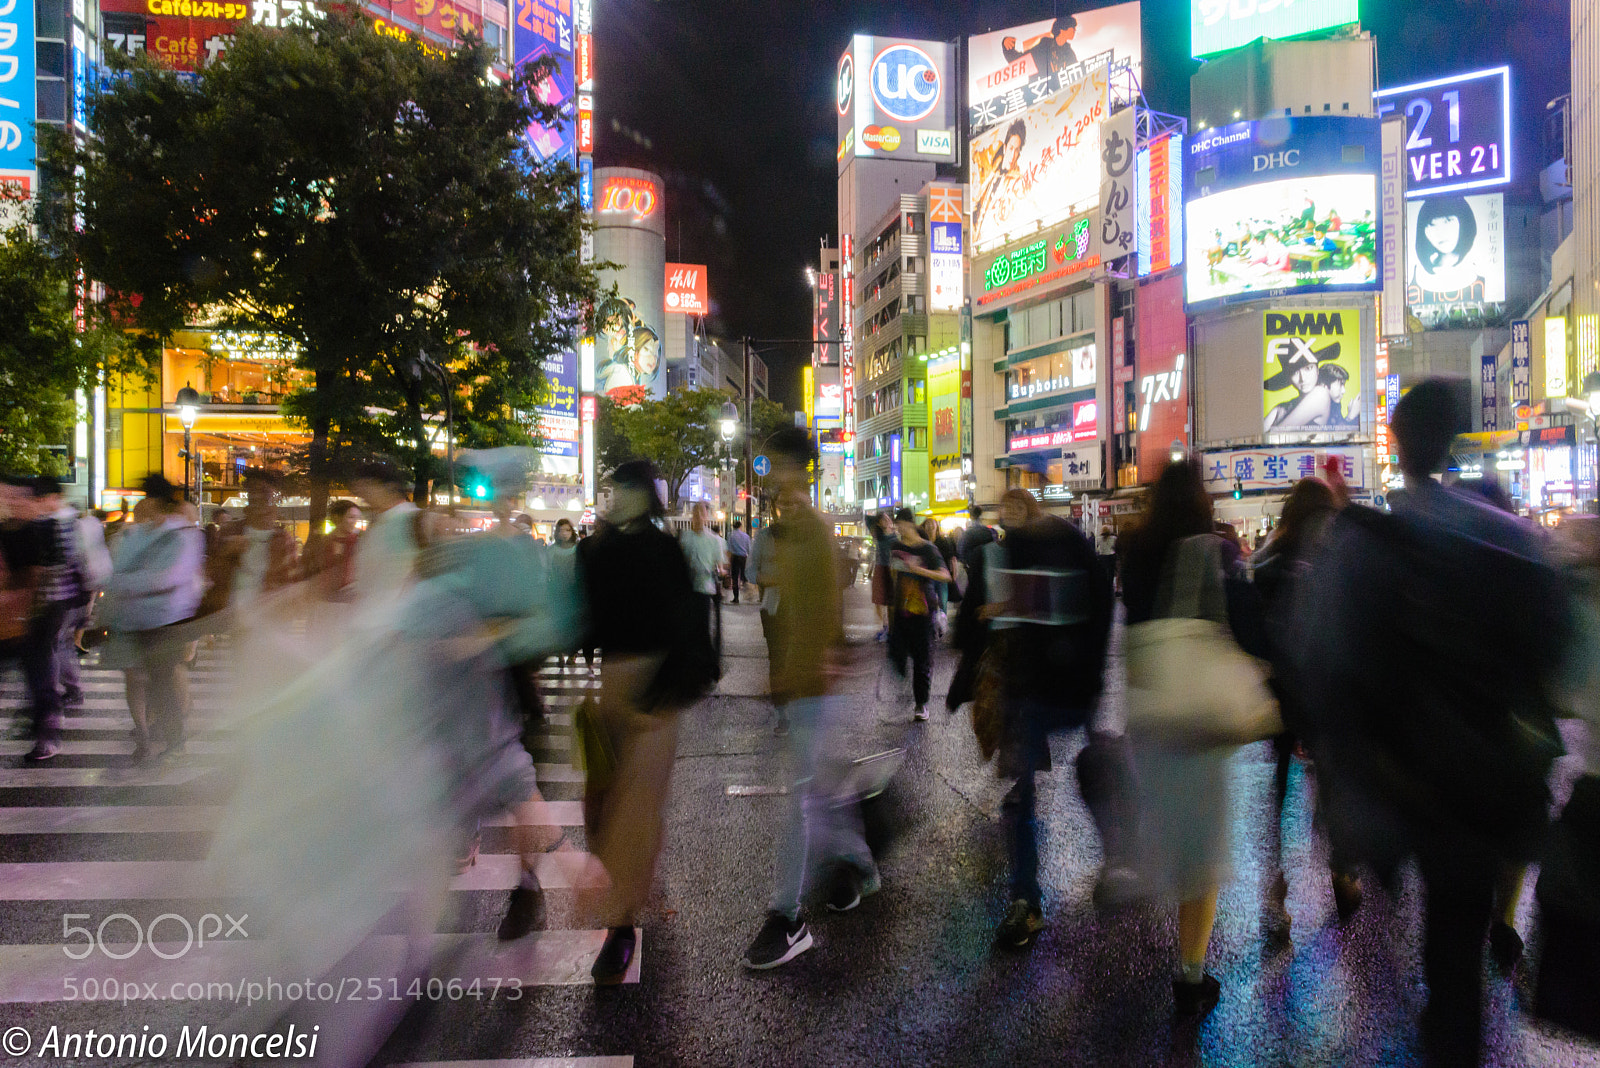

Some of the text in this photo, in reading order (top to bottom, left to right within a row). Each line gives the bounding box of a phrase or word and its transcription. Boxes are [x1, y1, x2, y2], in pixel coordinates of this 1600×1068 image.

[155, 36, 199, 55] Café
[878, 62, 937, 103] UC
[987, 60, 1026, 89] LOSER
[973, 62, 1083, 125] 米津玄師
[1074, 100, 1101, 136] 2016
[863, 133, 900, 143] MasterCard
[922, 136, 950, 149] VISA
[1191, 129, 1250, 155] DHC Channel
[1253, 149, 1300, 172] DHC
[1470, 143, 1498, 174] 21
[599, 185, 657, 222] 109
[931, 188, 962, 223] 本
[1102, 130, 1133, 251] もんじゃ
[1383, 146, 1398, 281] Taisei neon
[669, 269, 697, 290] H&M
[820, 273, 828, 363] KATE
[1266, 313, 1344, 336] DMM
[1266, 338, 1318, 363] FX
[1513, 324, 1528, 400] 洋服の青山
[1012, 374, 1070, 398] Euphoria
